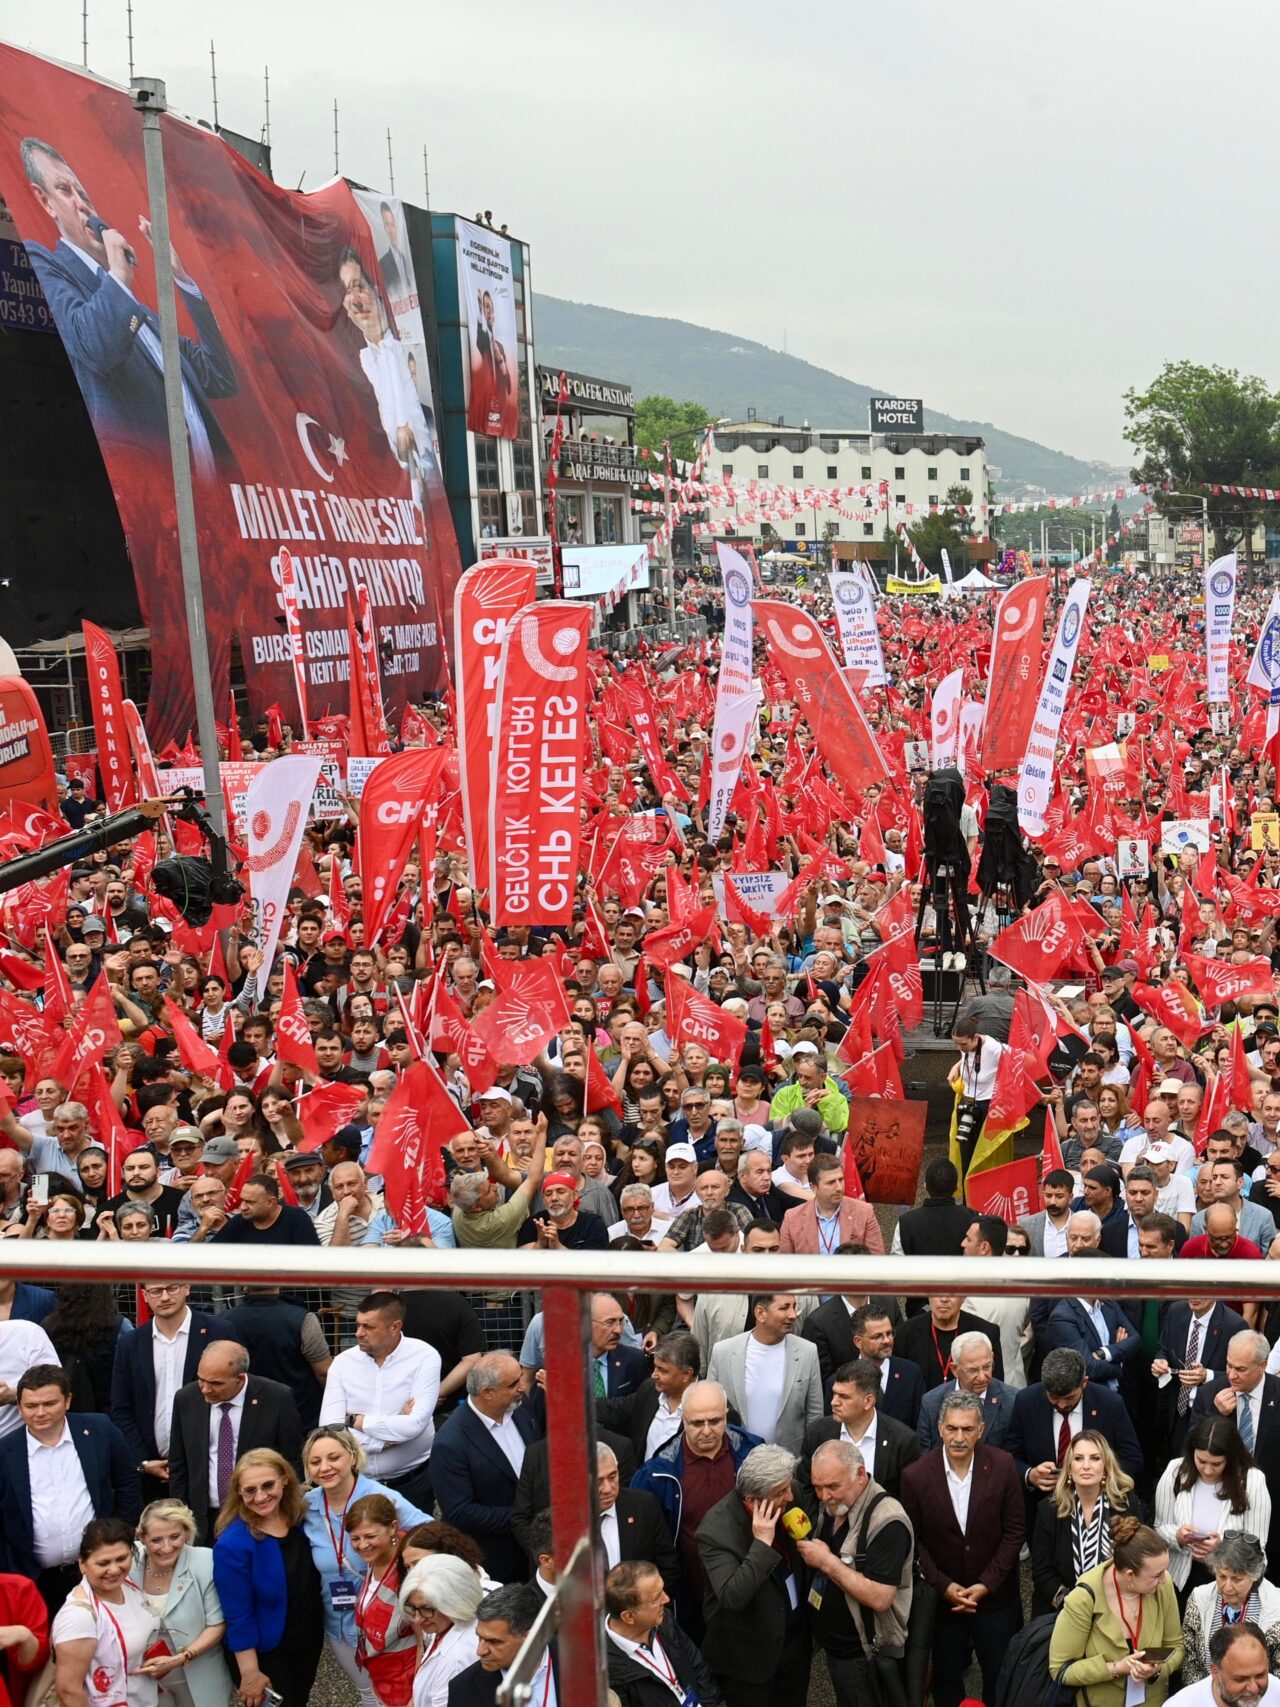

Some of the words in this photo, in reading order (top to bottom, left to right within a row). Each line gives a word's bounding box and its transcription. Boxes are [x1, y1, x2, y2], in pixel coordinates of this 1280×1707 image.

[0, 300, 34, 324] 0543
[875, 400, 918, 413] KARDEŞ
[878, 413, 916, 424] HOTEL
[1215, 605, 1230, 616] 2000
[394, 623, 421, 650] MAYIS
[309, 661, 334, 685] KENT
[1025, 763, 1046, 780] Gelsin
[1103, 781, 1126, 792] CHP
[1094, 824, 1115, 843] CHP
[1041, 920, 1068, 954] CHP
[888, 973, 914, 1002] CHP
[1215, 979, 1252, 998] CHP
[279, 1015, 313, 1046] CHP
